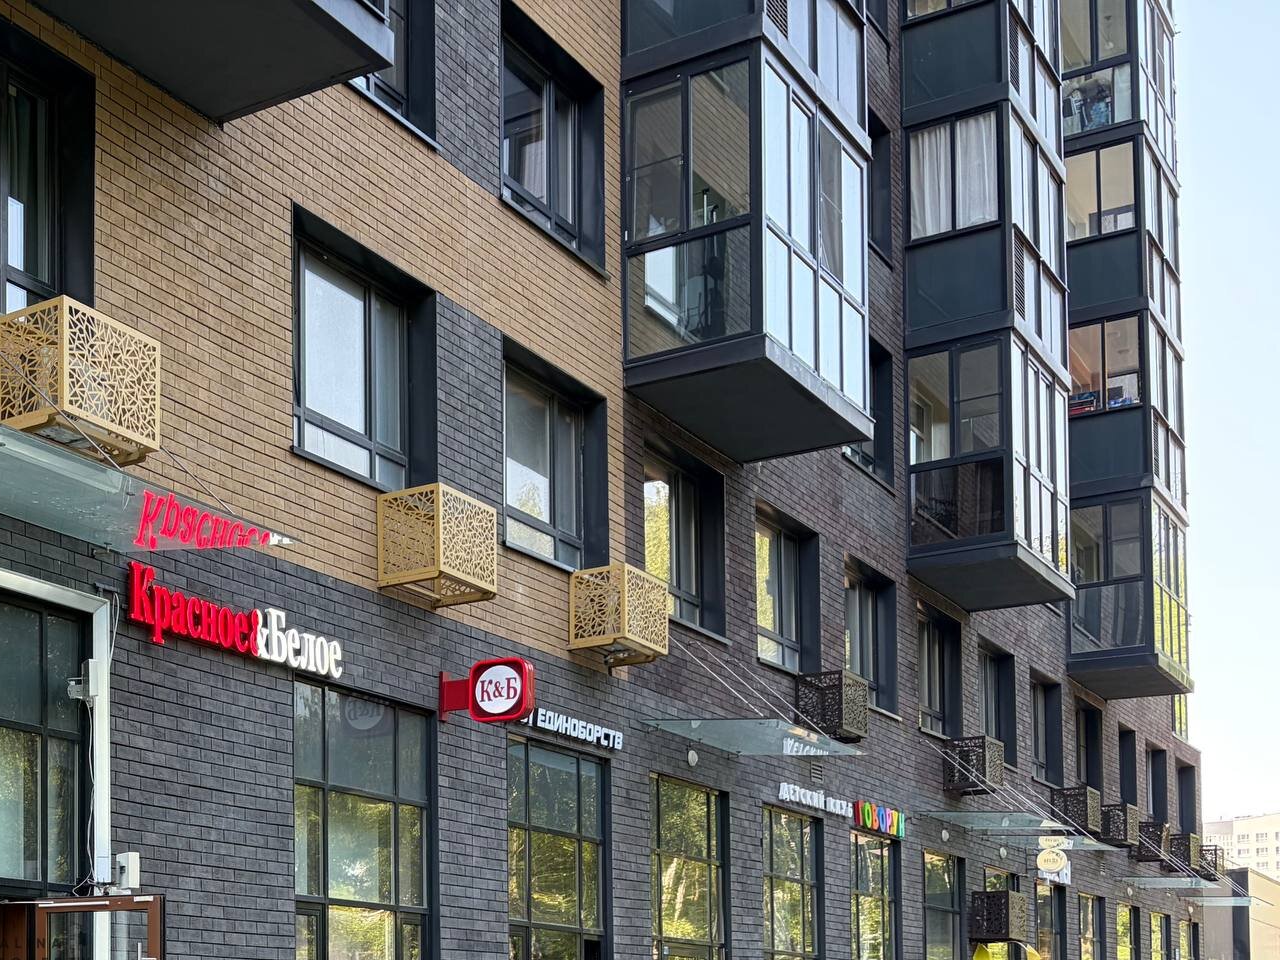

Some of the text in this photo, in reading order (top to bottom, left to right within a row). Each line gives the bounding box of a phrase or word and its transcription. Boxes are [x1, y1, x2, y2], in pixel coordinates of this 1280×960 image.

[479, 676, 518, 703] К&Б
[537, 708, 624, 750] ЕДИНОБОРСТВ
[778, 782, 825, 809] ДЕТСКИЙ
[854, 799, 905, 838] ГОВОРУН
